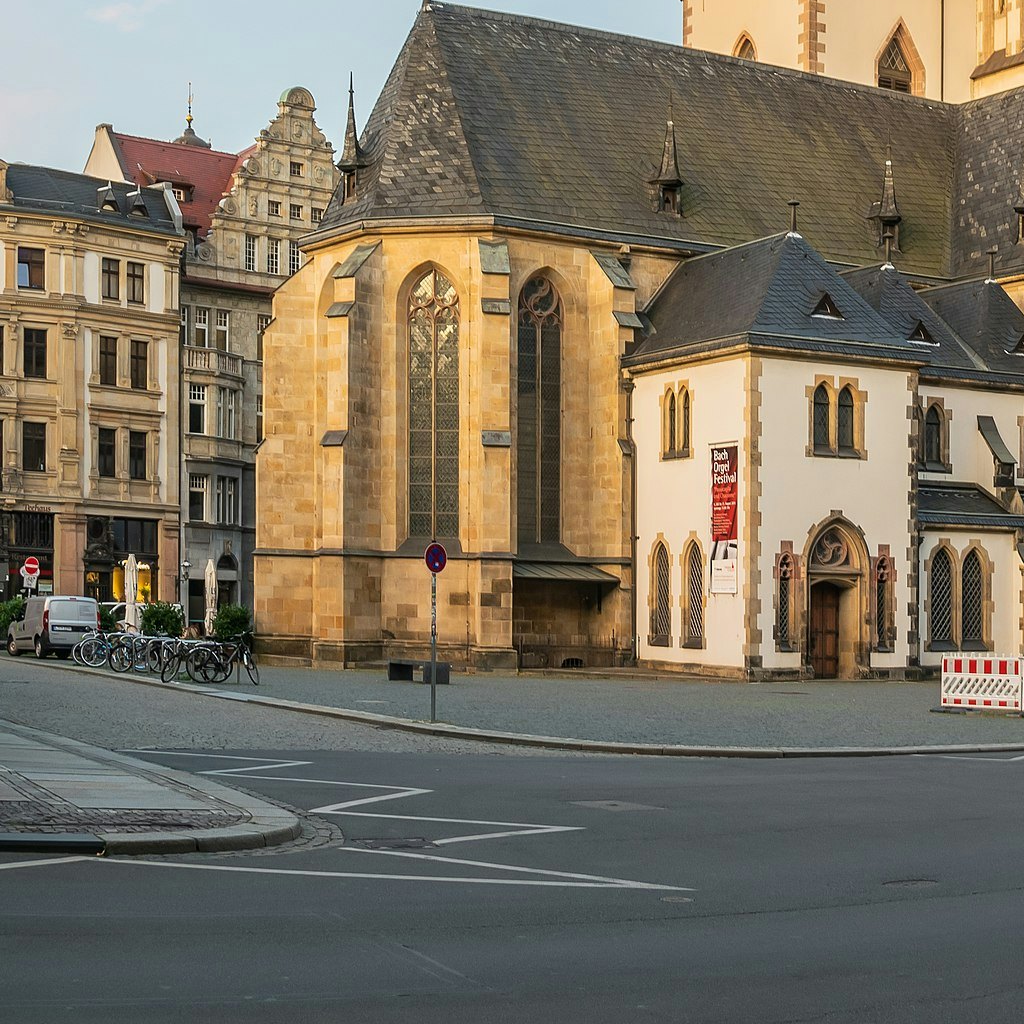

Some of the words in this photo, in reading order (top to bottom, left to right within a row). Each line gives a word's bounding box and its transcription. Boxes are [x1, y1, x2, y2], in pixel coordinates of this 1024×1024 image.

[713, 449, 728, 461] Bach
[713, 460, 730, 475] Orgel
[713, 471, 737, 484] Festival
